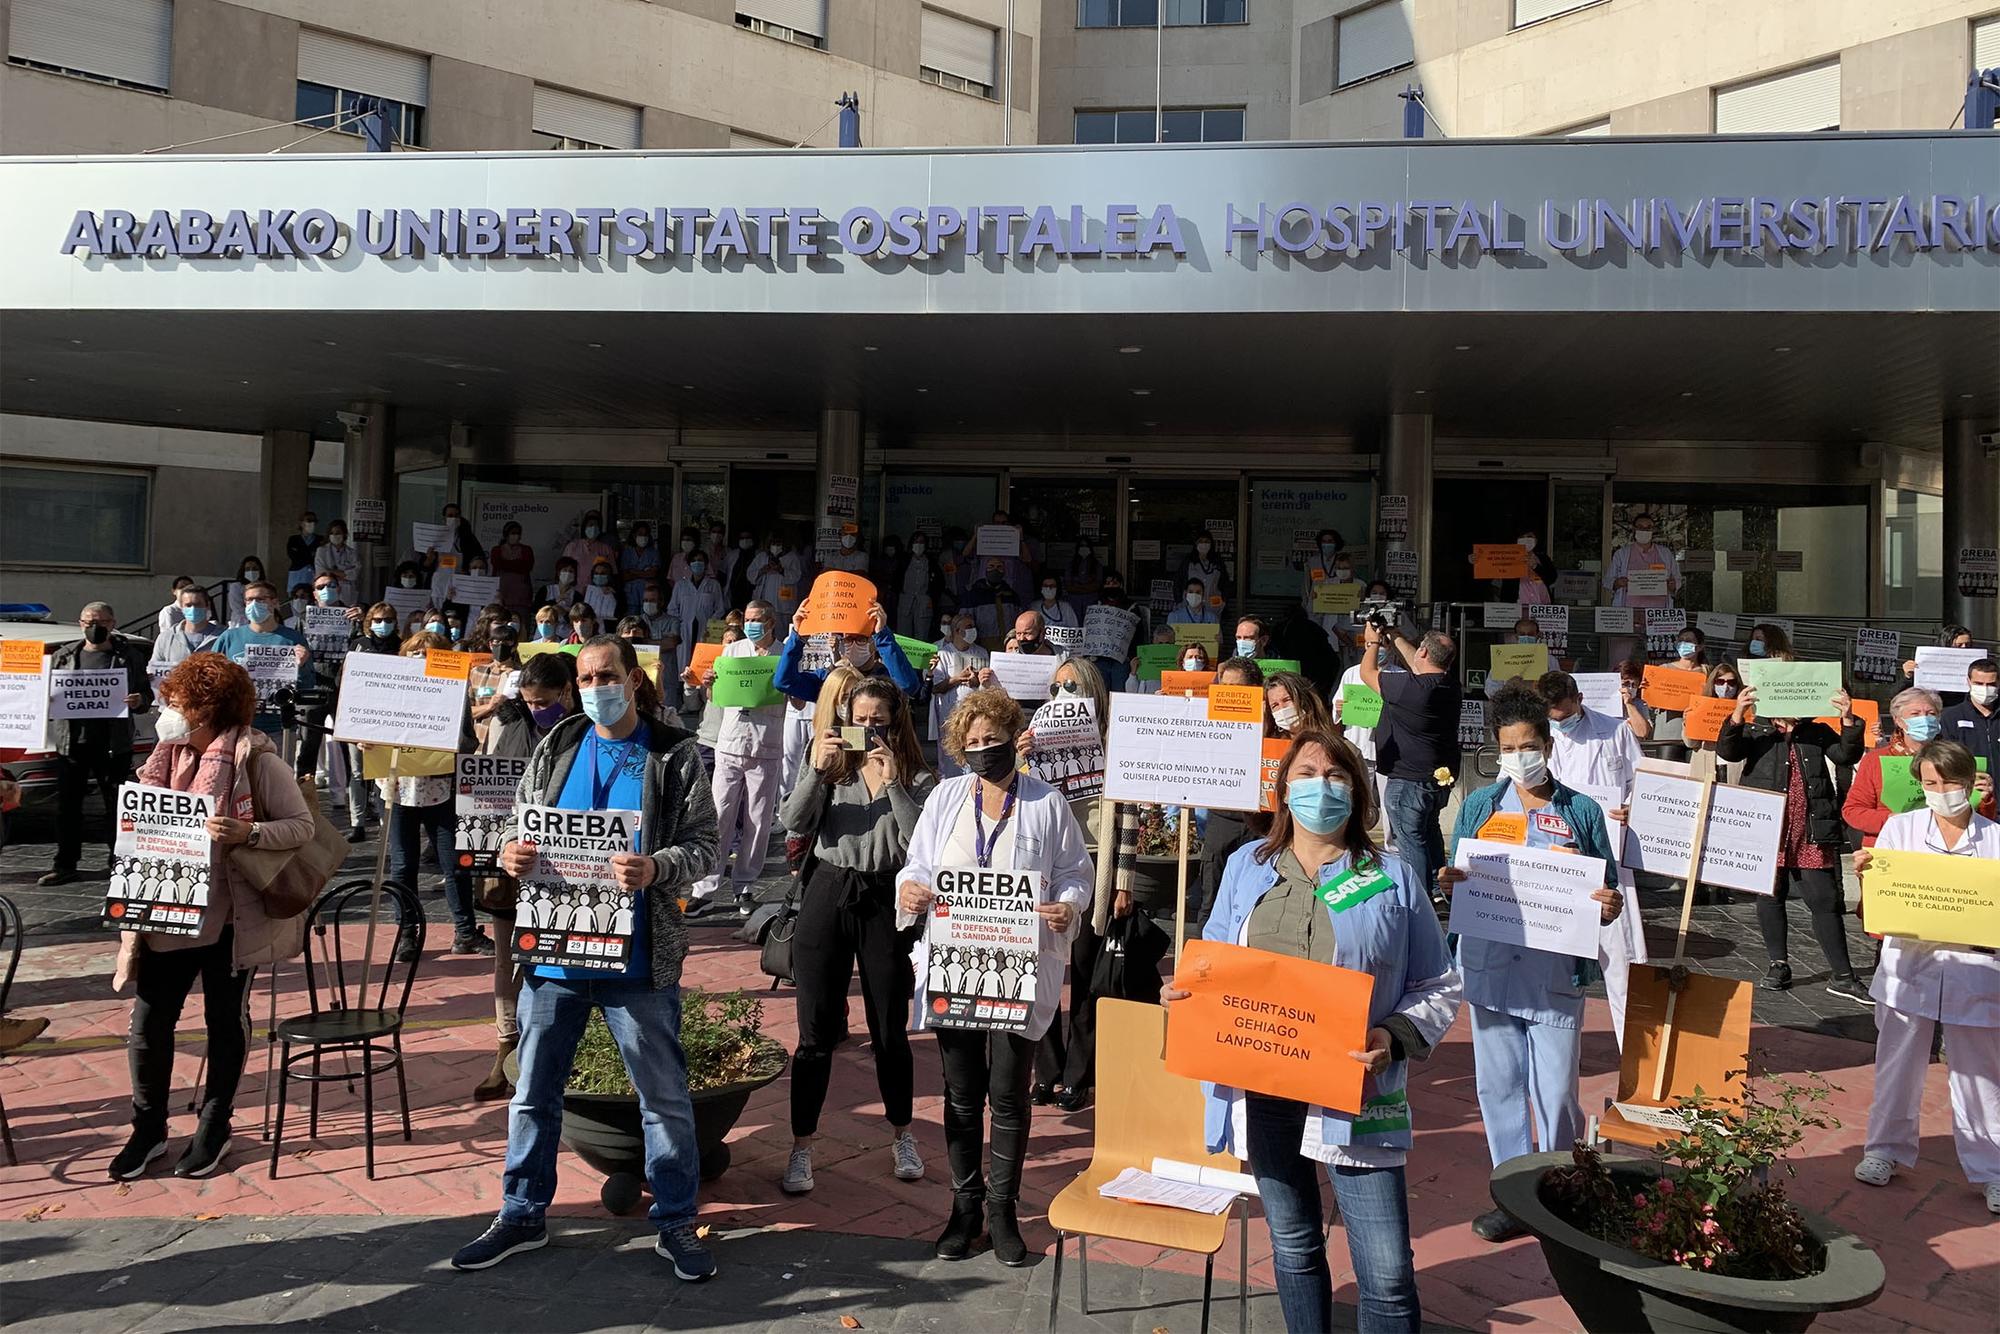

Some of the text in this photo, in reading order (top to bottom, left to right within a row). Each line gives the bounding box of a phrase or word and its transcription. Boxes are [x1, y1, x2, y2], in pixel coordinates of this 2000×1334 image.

[60, 193, 2000, 255] ARABAKO UNIBERTSITATE OSPITALEA HOSPITAL UNIVERSITARI
[1298, 489, 1347, 501] gabeko
[511, 503, 550, 514] gabeko
[1962, 549, 1997, 558] GREBA
[1531, 606, 1566, 614] GREBA
[1647, 609, 1683, 617] GREBA
[1045, 627, 1083, 638] GREBA
[1860, 629, 1897, 641] GREBA
[247, 647, 296, 657] HUELGA
[246, 660, 296, 668] OSAKIDETZA
[55, 678, 119, 687] HONAINO
[350, 669, 459, 686] GUTXIENEKO ZERBITZUA NAIZ ETA
[365, 680, 442, 694] EZIN NAIZ HEMEN EGON
[64, 690, 110, 699] HELDU
[1216, 691, 1251, 699] ZERBITZU
[67, 701, 109, 710] GARA!
[1216, 698, 1252, 706] MINIMOAK
[348, 706, 361, 714] SOY
[362, 708, 392, 717] SERVICIO
[393, 710, 421, 720] MÍNIMO
[1035, 701, 1090, 721] GREBA
[350, 717, 445, 731] QUISIERA PUEDO ESTAR AQUÍ
[1118, 715, 1253, 730] GUTXIENEKO ZERBITZUA NAIZ ETA
[1156, 729, 1175, 737] NAIZ
[1176, 730, 1206, 739] HEMEN
[1208, 732, 1232, 740] EGON
[460, 757, 526, 776] GREB
[1119, 760, 1135, 768] SOY
[1136, 761, 1173, 771] SERVICIO
[1174, 763, 1209, 774] MÍNIMO
[1218, 767, 1227, 775] NI
[1229, 768, 1246, 776] TAN
[1122, 772, 1241, 788] QUISIERA PUEDO ESTAR AQUÍ
[123, 790, 208, 818] GREBA
[1640, 792, 1772, 821] GUTXIENEKO NAIZ ETA
[523, 808, 627, 839] GREBA
[1540, 817, 1567, 831] LAB
[1658, 806, 1751, 828] EZIN NAIZ EGON
[136, 828, 192, 840] MURRIZKETARIK
[147, 837, 178, 847] DEFENSA
[523, 833, 629, 852] OSAKIDETZAN
[1639, 833, 1654, 841] SOY
[1656, 836, 1691, 849] SERVICIO
[1746, 853, 1763, 862] TAN
[146, 844, 175, 855] SANIDAD
[540, 852, 610, 863] MURRIZKETARIK
[1642, 845, 1757, 872] QUISIERA ESTAR AQUÍ
[540, 860, 552, 868] EN
[553, 862, 591, 871] DEFENSA
[1476, 853, 1503, 864] DIDATE
[1505, 857, 1530, 868] GREBA
[1532, 862, 1559, 873] EGITEN
[1561, 867, 1586, 878] UZTEN
[540, 868, 589, 879] LA SANIDAD
[936, 870, 1034, 899] GREBA
[1323, 869, 1383, 905] SATSE
[1466, 870, 1573, 895] GUTXIENEKO ZERBITZUAK NAIZ
[1892, 881, 1917, 890] AHORA
[1918, 884, 1934, 892] MÁS
[1952, 888, 1979, 896] NUNCA
[935, 894, 1034, 913] OSAKIDETZAN
[1468, 889, 1574, 915] NO ME DEJAN HACER HUELGA
[1877, 889, 1955, 904] ¡POR UNA SANIDAD
[1925, 902, 1965, 912] CALIDAD!
[951, 913, 1029, 926] MURRIZKETARIK EZ
[1475, 911, 1563, 933] SOY SERVICIOS MÍNIMOS
[951, 922, 1012, 934] EN DEFENSA DE
[962, 932, 997, 942] SANIDAD
[999, 934, 1033, 945] PÚBLICA
[1222, 994, 1316, 1024] SEGURTASUN
[1234, 1016, 1298, 1040] GEHIAGO
[1216, 1031, 1311, 1061] LANPOSTUAN
[1355, 1100, 1407, 1122] SATSE
